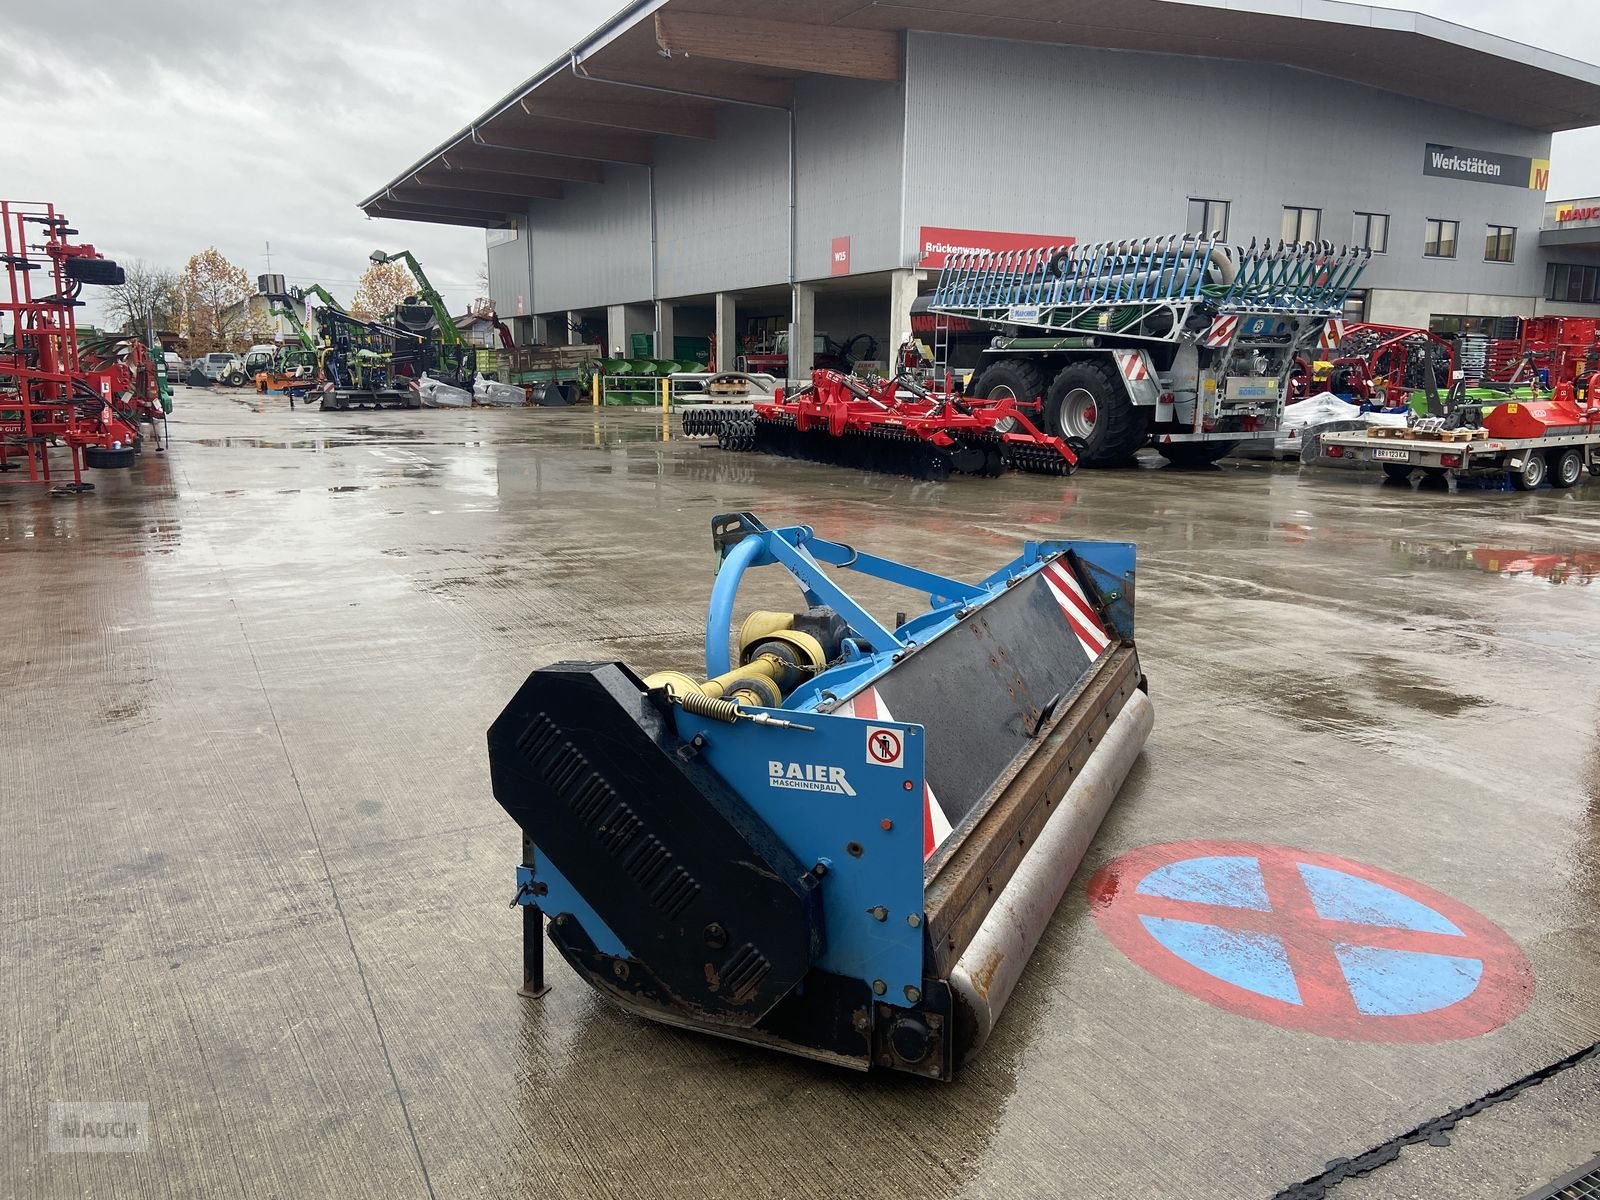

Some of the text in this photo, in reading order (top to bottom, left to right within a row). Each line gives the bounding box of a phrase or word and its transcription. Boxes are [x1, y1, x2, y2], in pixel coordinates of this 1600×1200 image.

[1431, 152, 1500, 176] Werkstätten
[768, 760, 857, 797] BAIER
[772, 779, 837, 792] MASCHINENBAU
